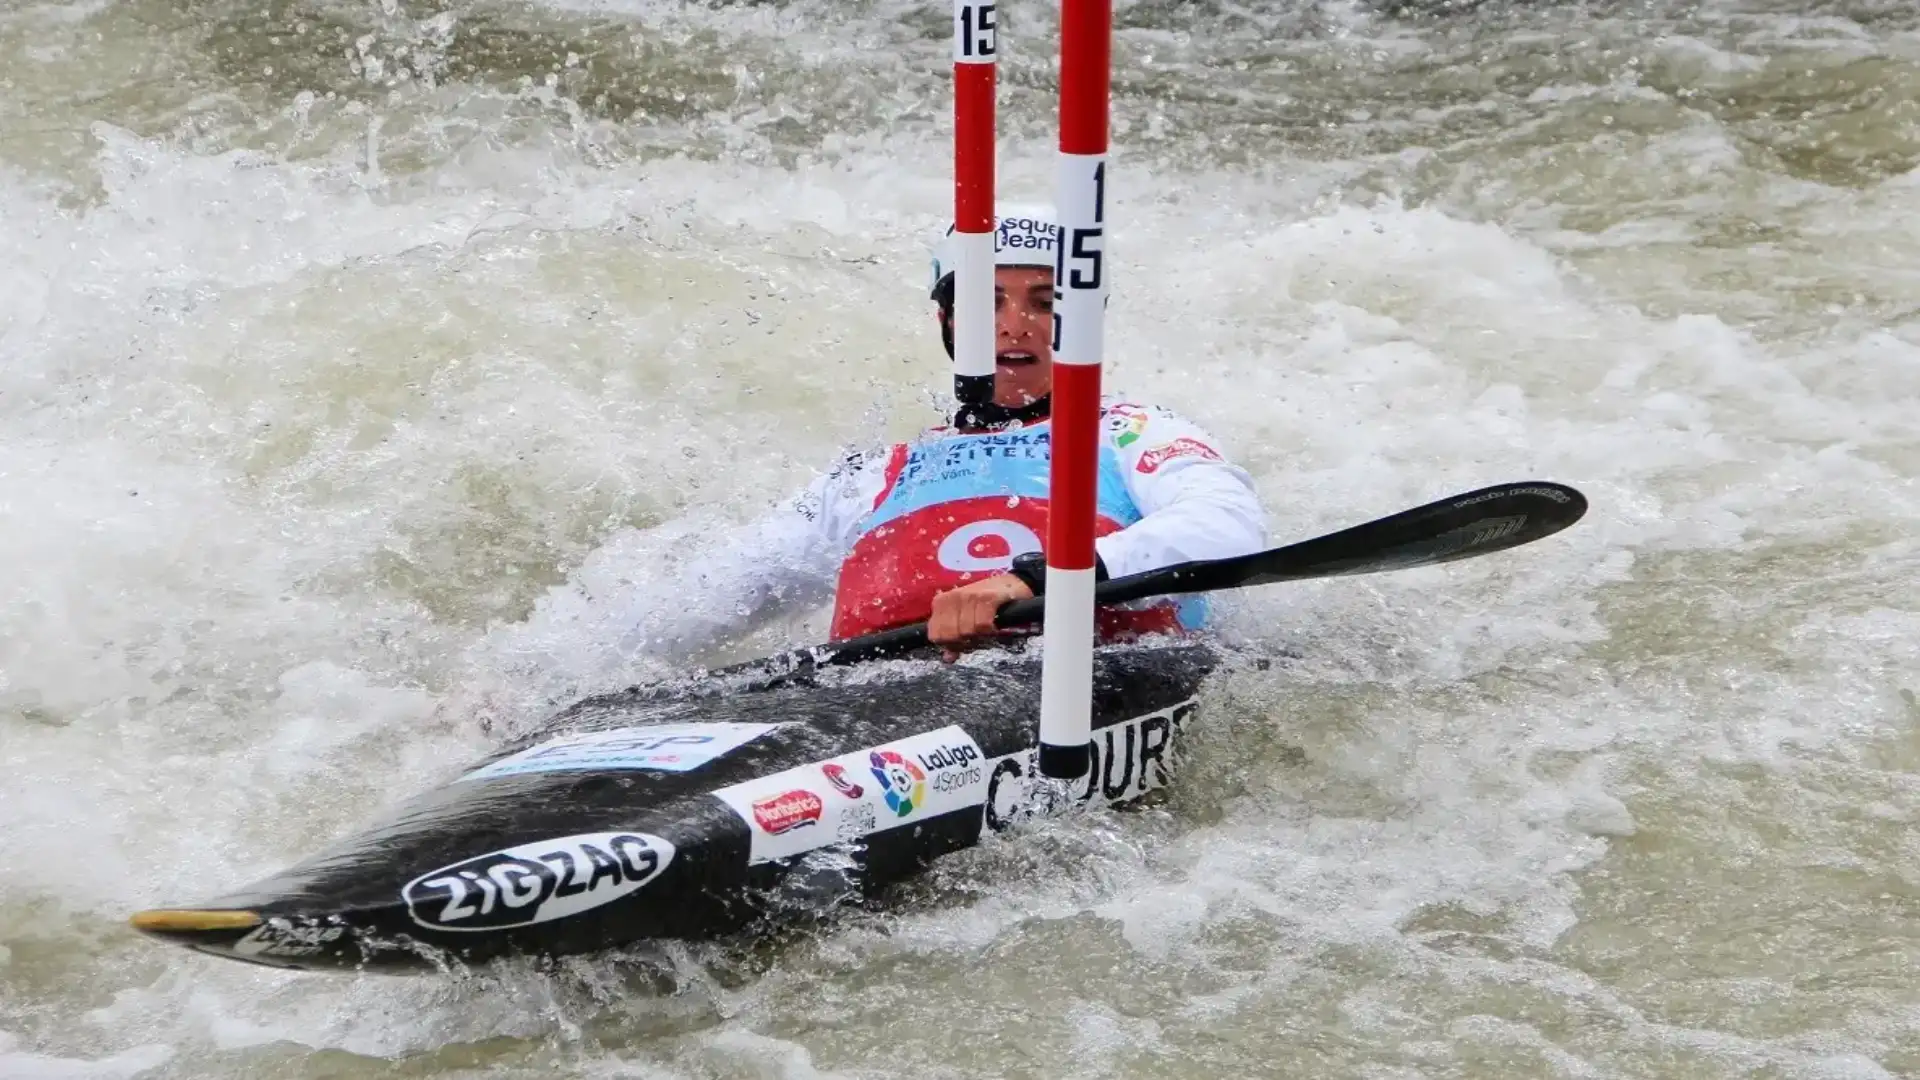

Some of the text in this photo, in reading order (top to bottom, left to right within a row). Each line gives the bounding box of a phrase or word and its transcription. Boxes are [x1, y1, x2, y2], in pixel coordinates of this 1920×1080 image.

[961, 6, 996, 56] 15
[996, 216, 1057, 237] sque
[1057, 226, 1102, 290] 15
[917, 745, 978, 772] LaLiga
[932, 767, 981, 795] 4Sports
